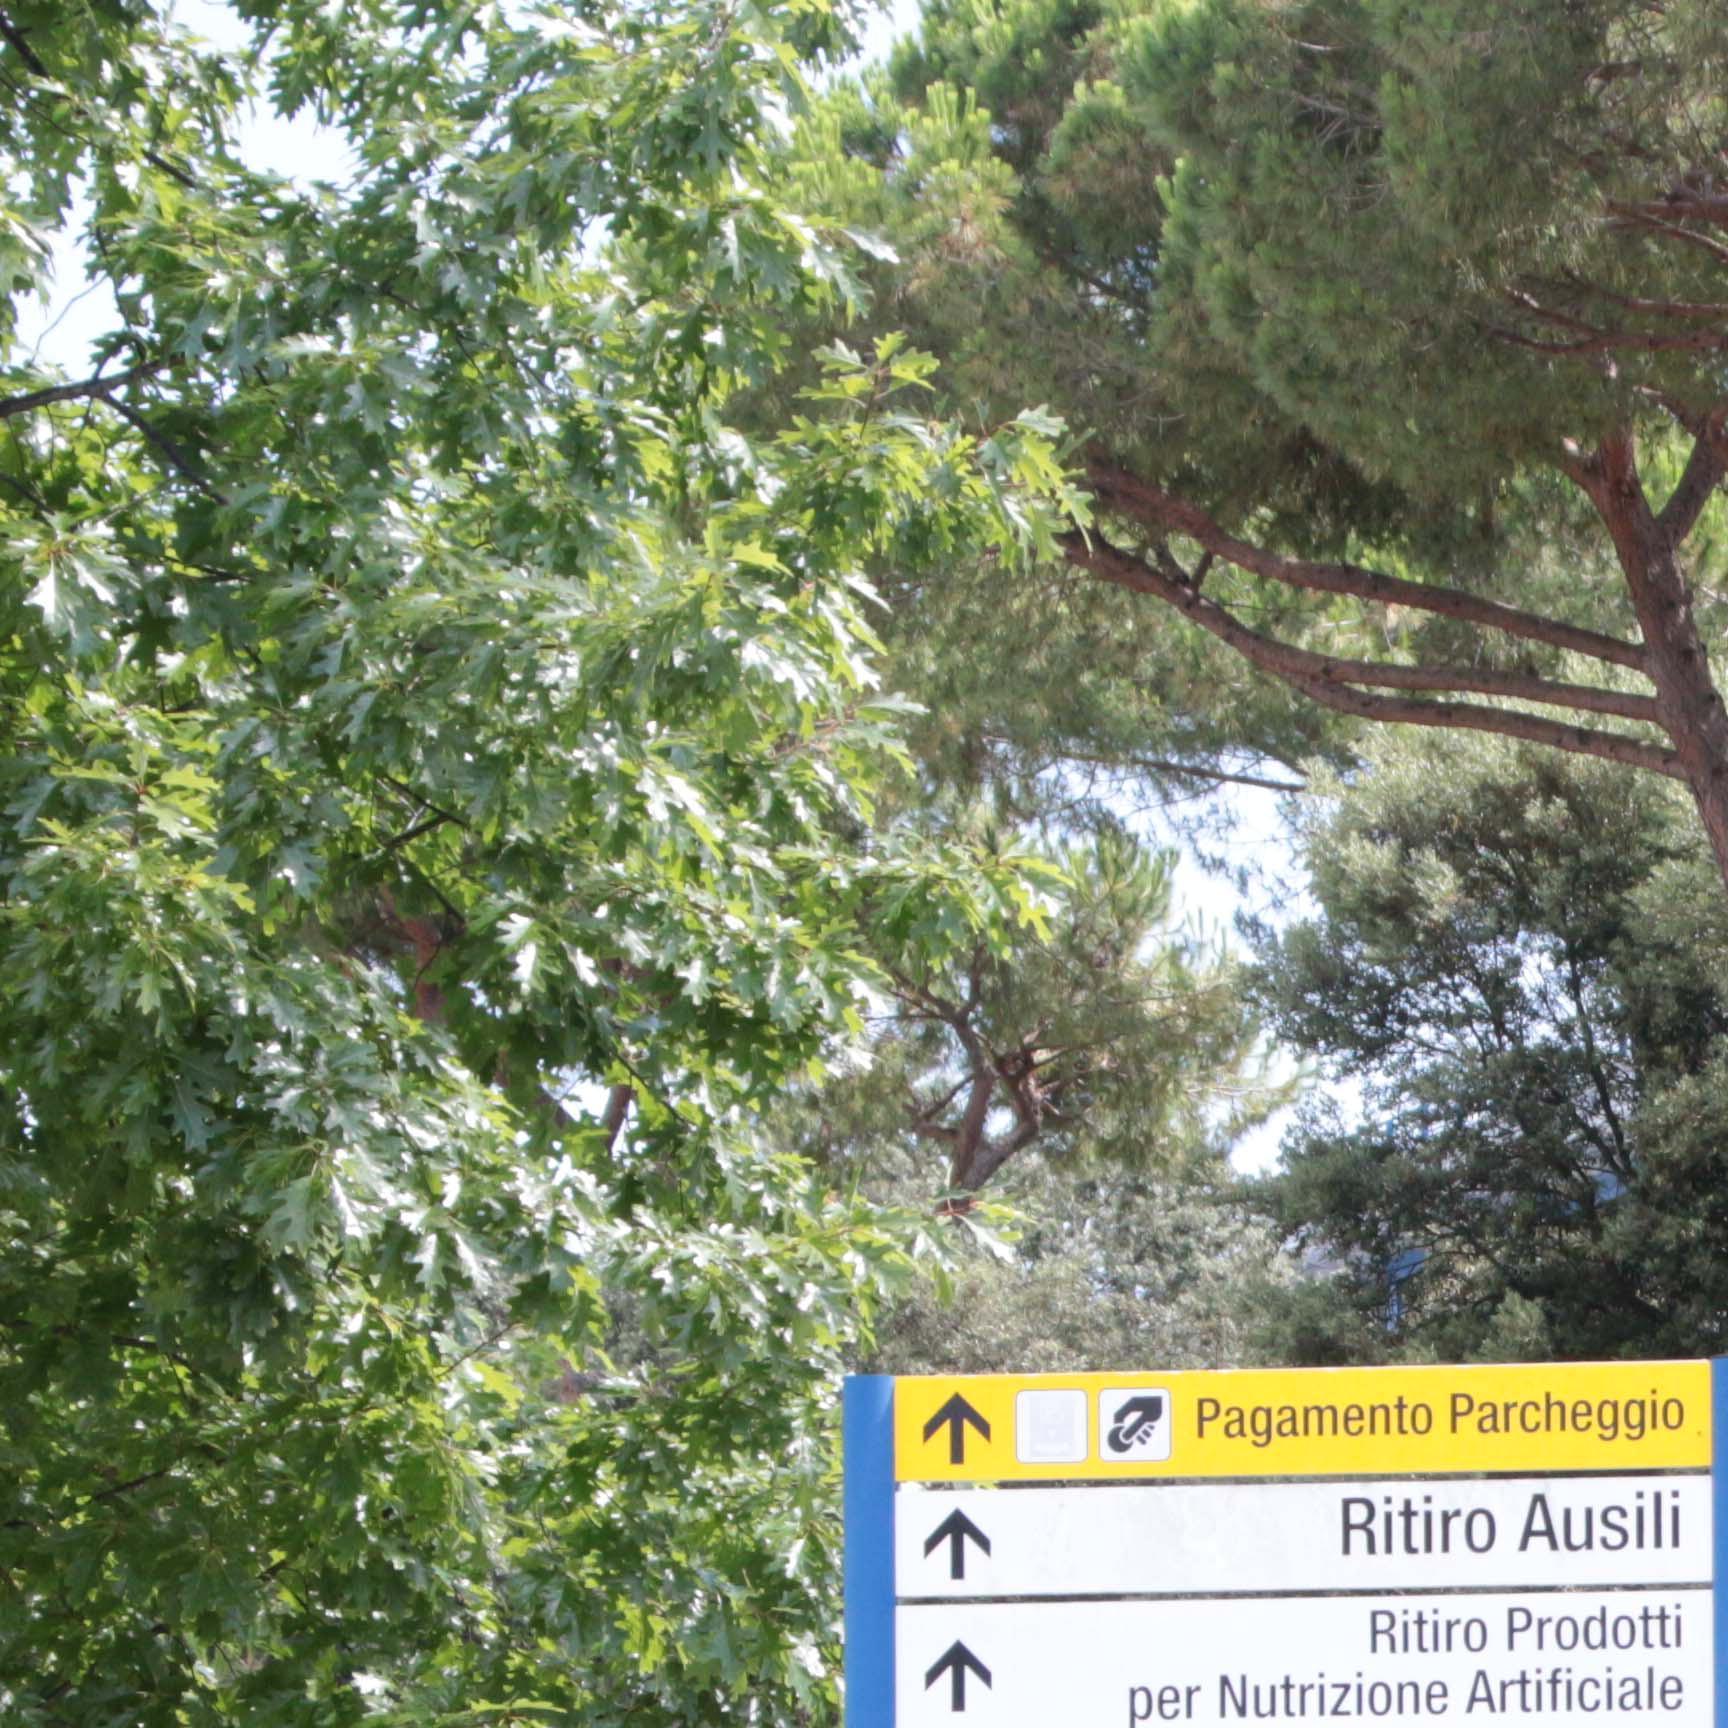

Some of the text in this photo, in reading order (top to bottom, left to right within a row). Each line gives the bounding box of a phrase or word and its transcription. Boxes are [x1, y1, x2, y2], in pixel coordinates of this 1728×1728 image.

[1197, 1391, 1684, 1447] Pagamento Parcheggio
[1341, 1490, 1681, 1556] Ritiro Ausili
[1370, 1605, 1682, 1654] Ritiro Prodotti
[1219, 1674, 1449, 1719] Nutrizione
[1465, 1666, 1683, 1714] Artificiale
